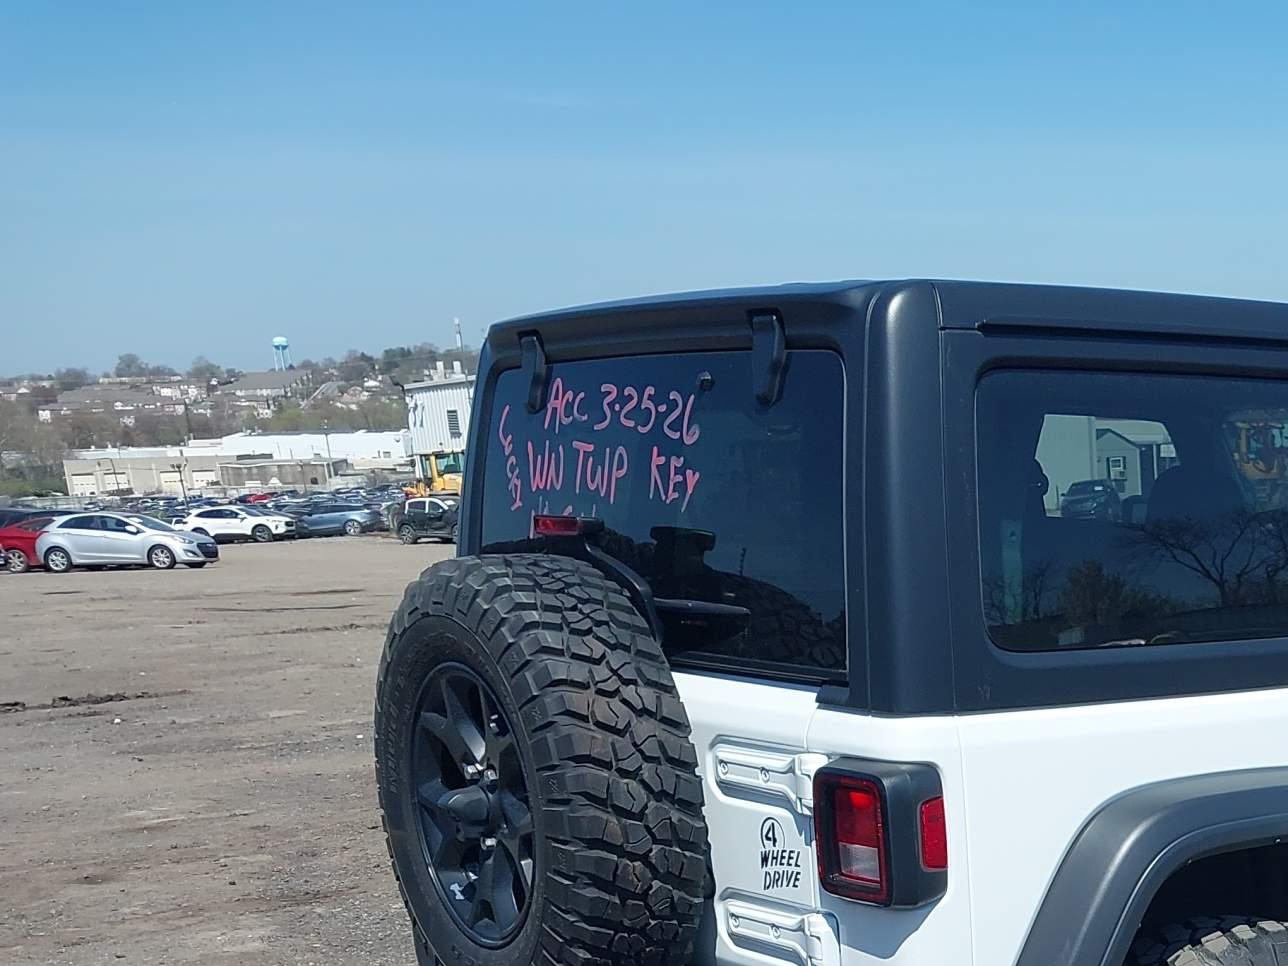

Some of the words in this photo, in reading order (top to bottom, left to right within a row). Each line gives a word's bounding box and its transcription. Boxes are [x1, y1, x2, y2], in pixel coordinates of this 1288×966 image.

[571, 439, 629, 505] TWP
[764, 822, 778, 848] 4
[760, 849, 801, 869] WHEEL
[763, 869, 802, 891] DRIVE
